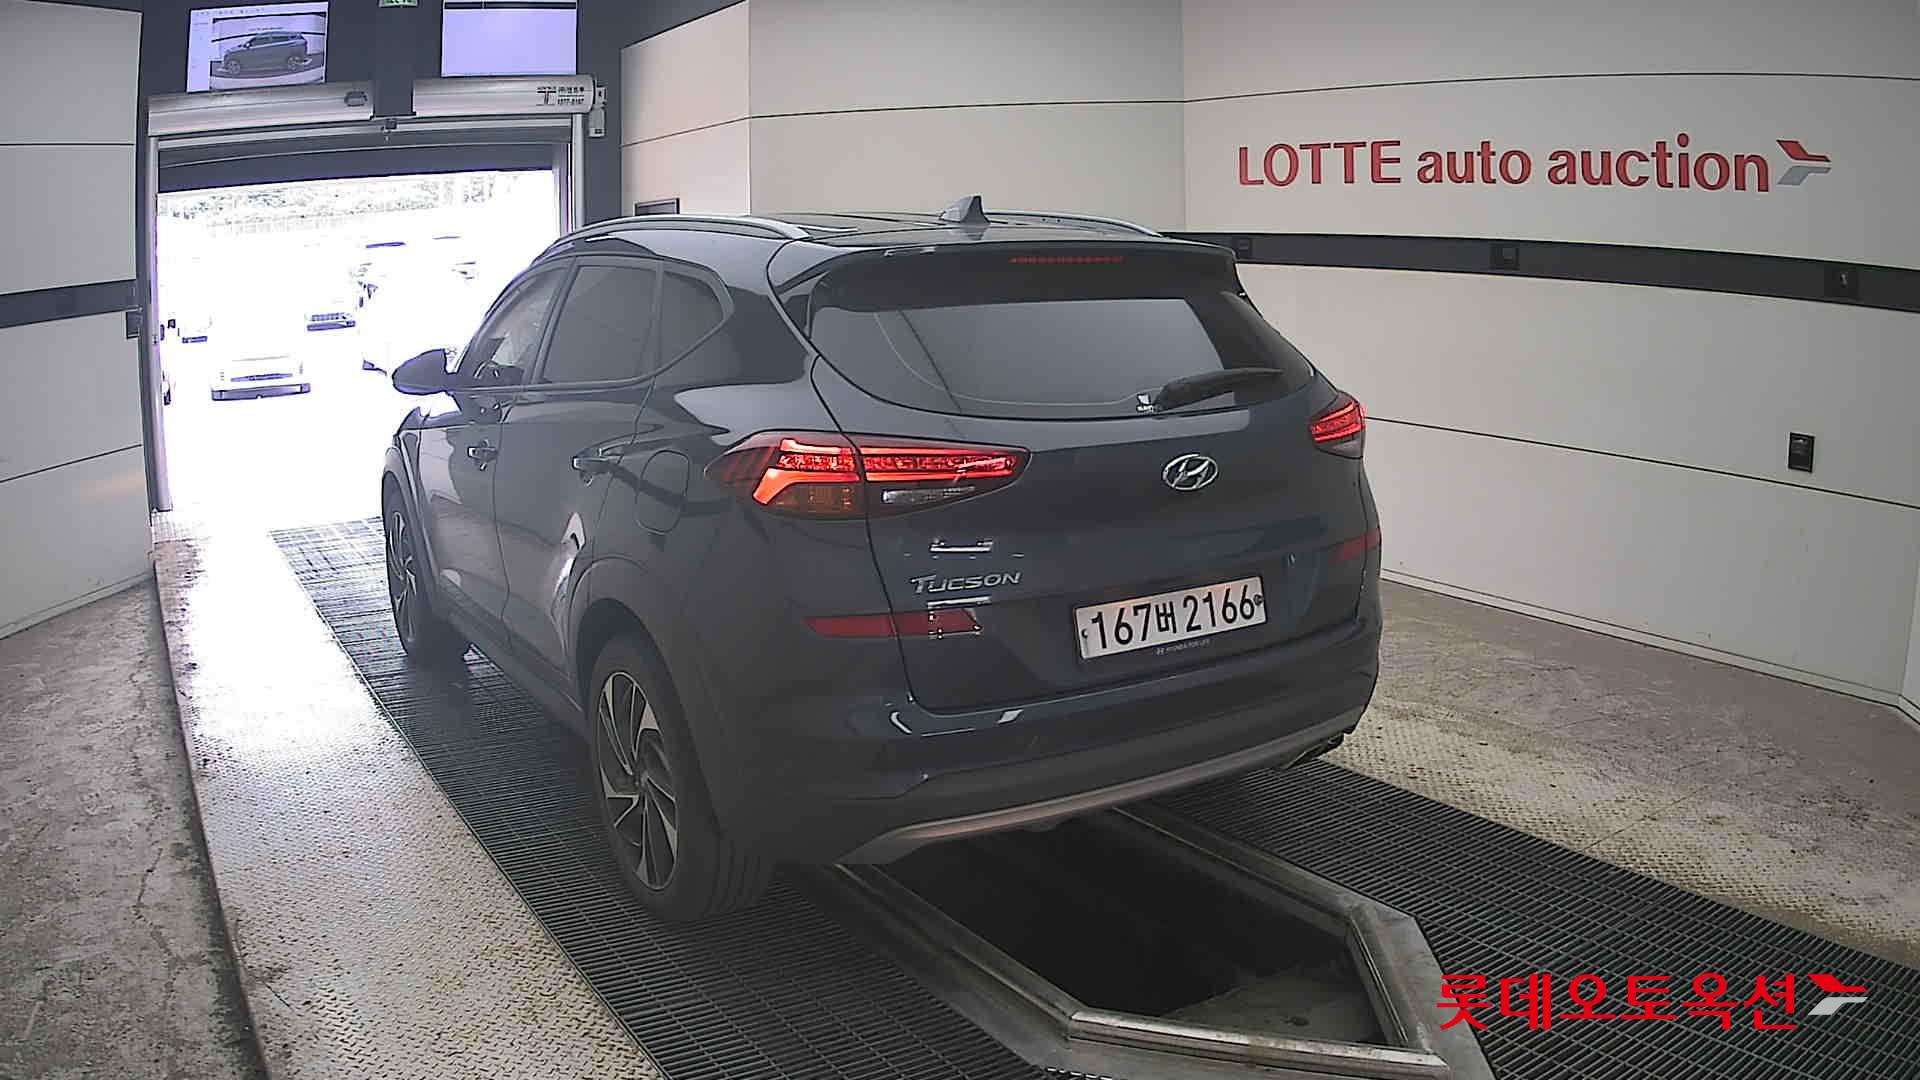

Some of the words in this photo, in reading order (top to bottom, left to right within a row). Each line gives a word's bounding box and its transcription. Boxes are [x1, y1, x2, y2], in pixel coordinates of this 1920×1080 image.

[1239, 140, 1400, 187] LOTTE
[1417, 141, 1532, 184] auto
[1547, 133, 1770, 192] auction
[911, 572, 1021, 593] TUCSON
